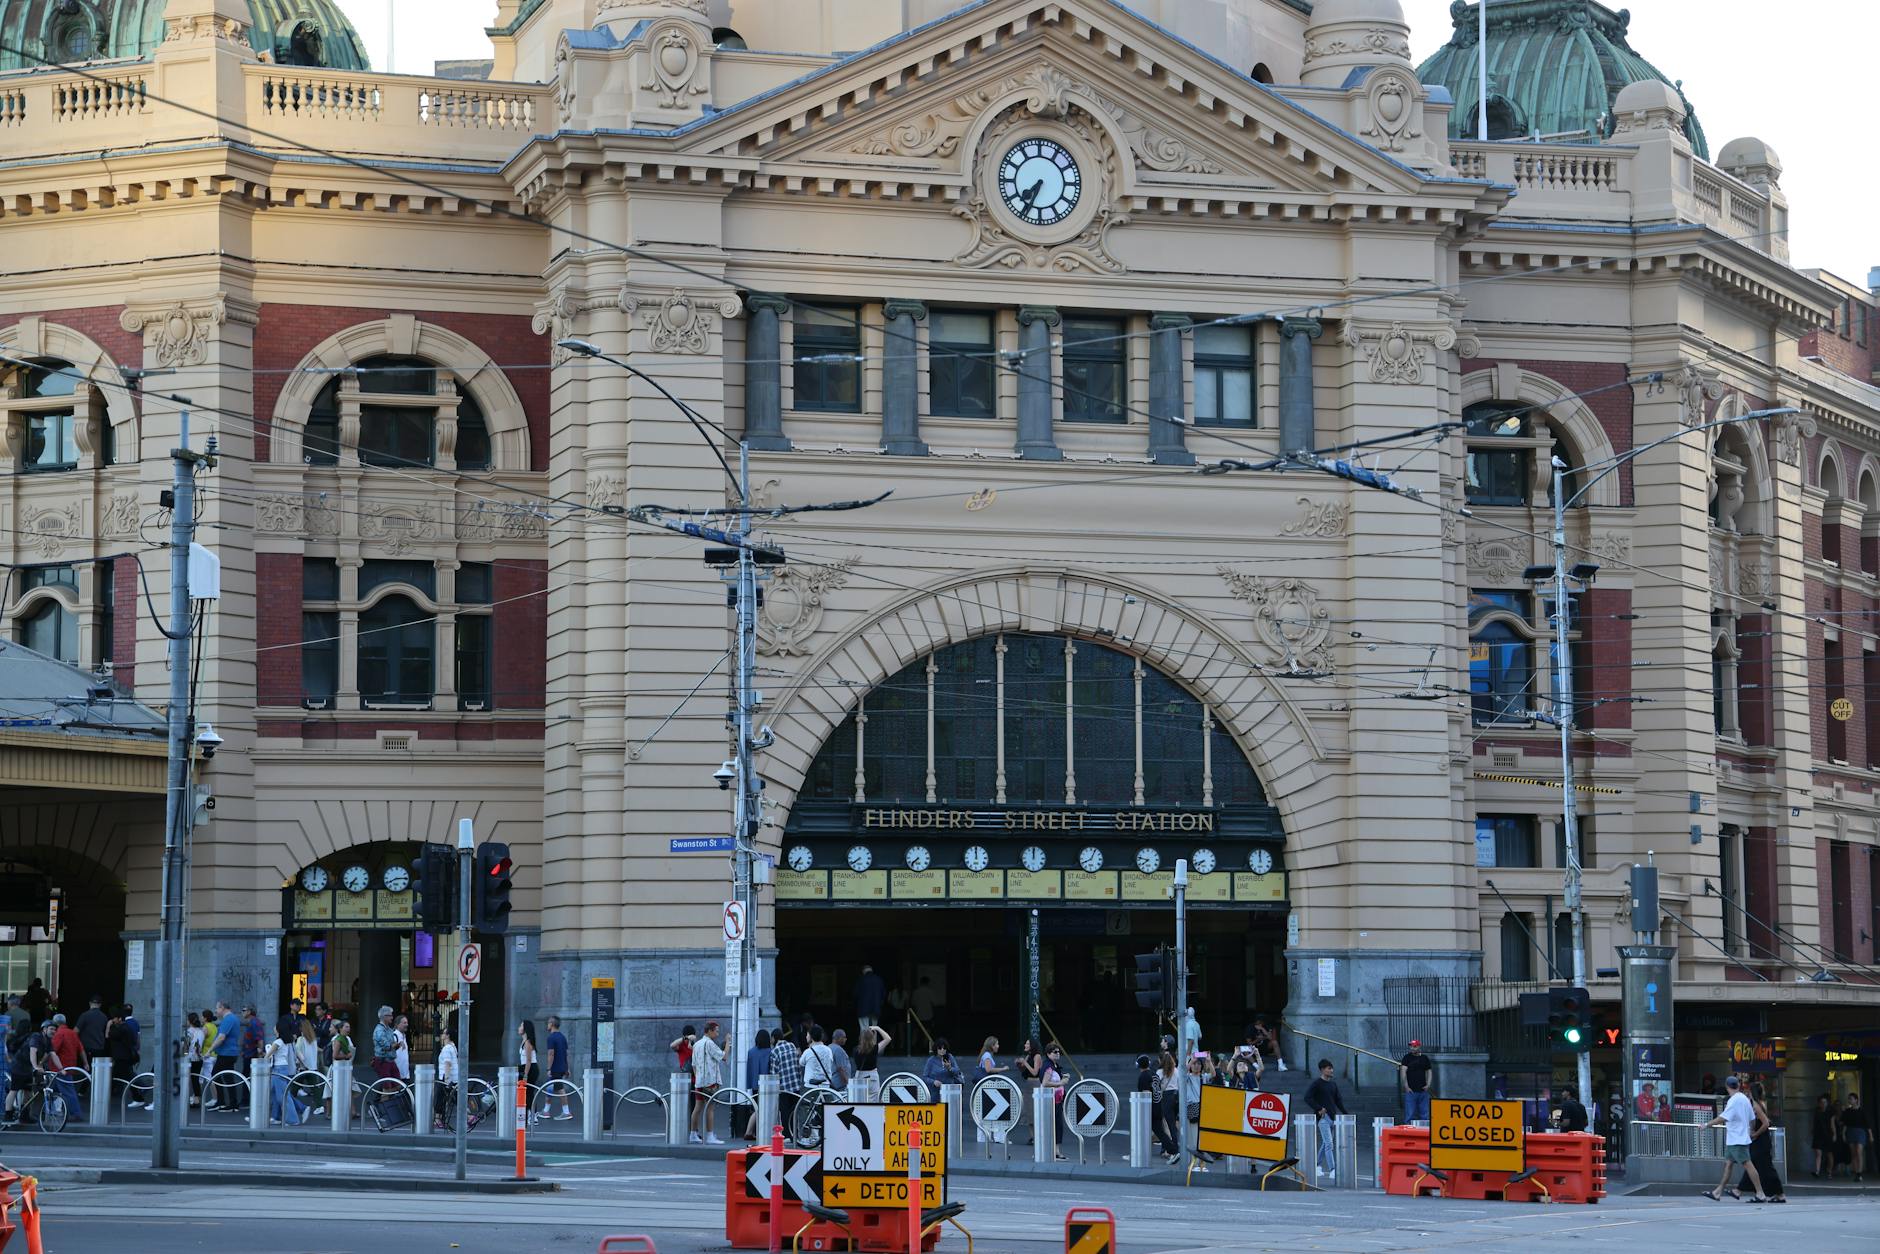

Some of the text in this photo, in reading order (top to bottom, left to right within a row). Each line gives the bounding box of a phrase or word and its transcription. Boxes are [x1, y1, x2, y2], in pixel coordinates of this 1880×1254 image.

[865, 809, 1213, 831] FLINDERS STREET STATION
[672, 840, 708, 848] Swanston
[709, 839, 717, 847] St
[1261, 1100, 1274, 1109] NO
[1450, 1104, 1503, 1120] ROAD
[898, 1110, 933, 1126] ROAD
[1252, 1118, 1280, 1130] ENTRY
[889, 1131, 941, 1147] CLED
[1439, 1125, 1515, 1142] CLOSED
[833, 1157, 870, 1170] ONLY
[892, 1152, 936, 1168] AHAD
[861, 1183, 935, 1201] DETOR
